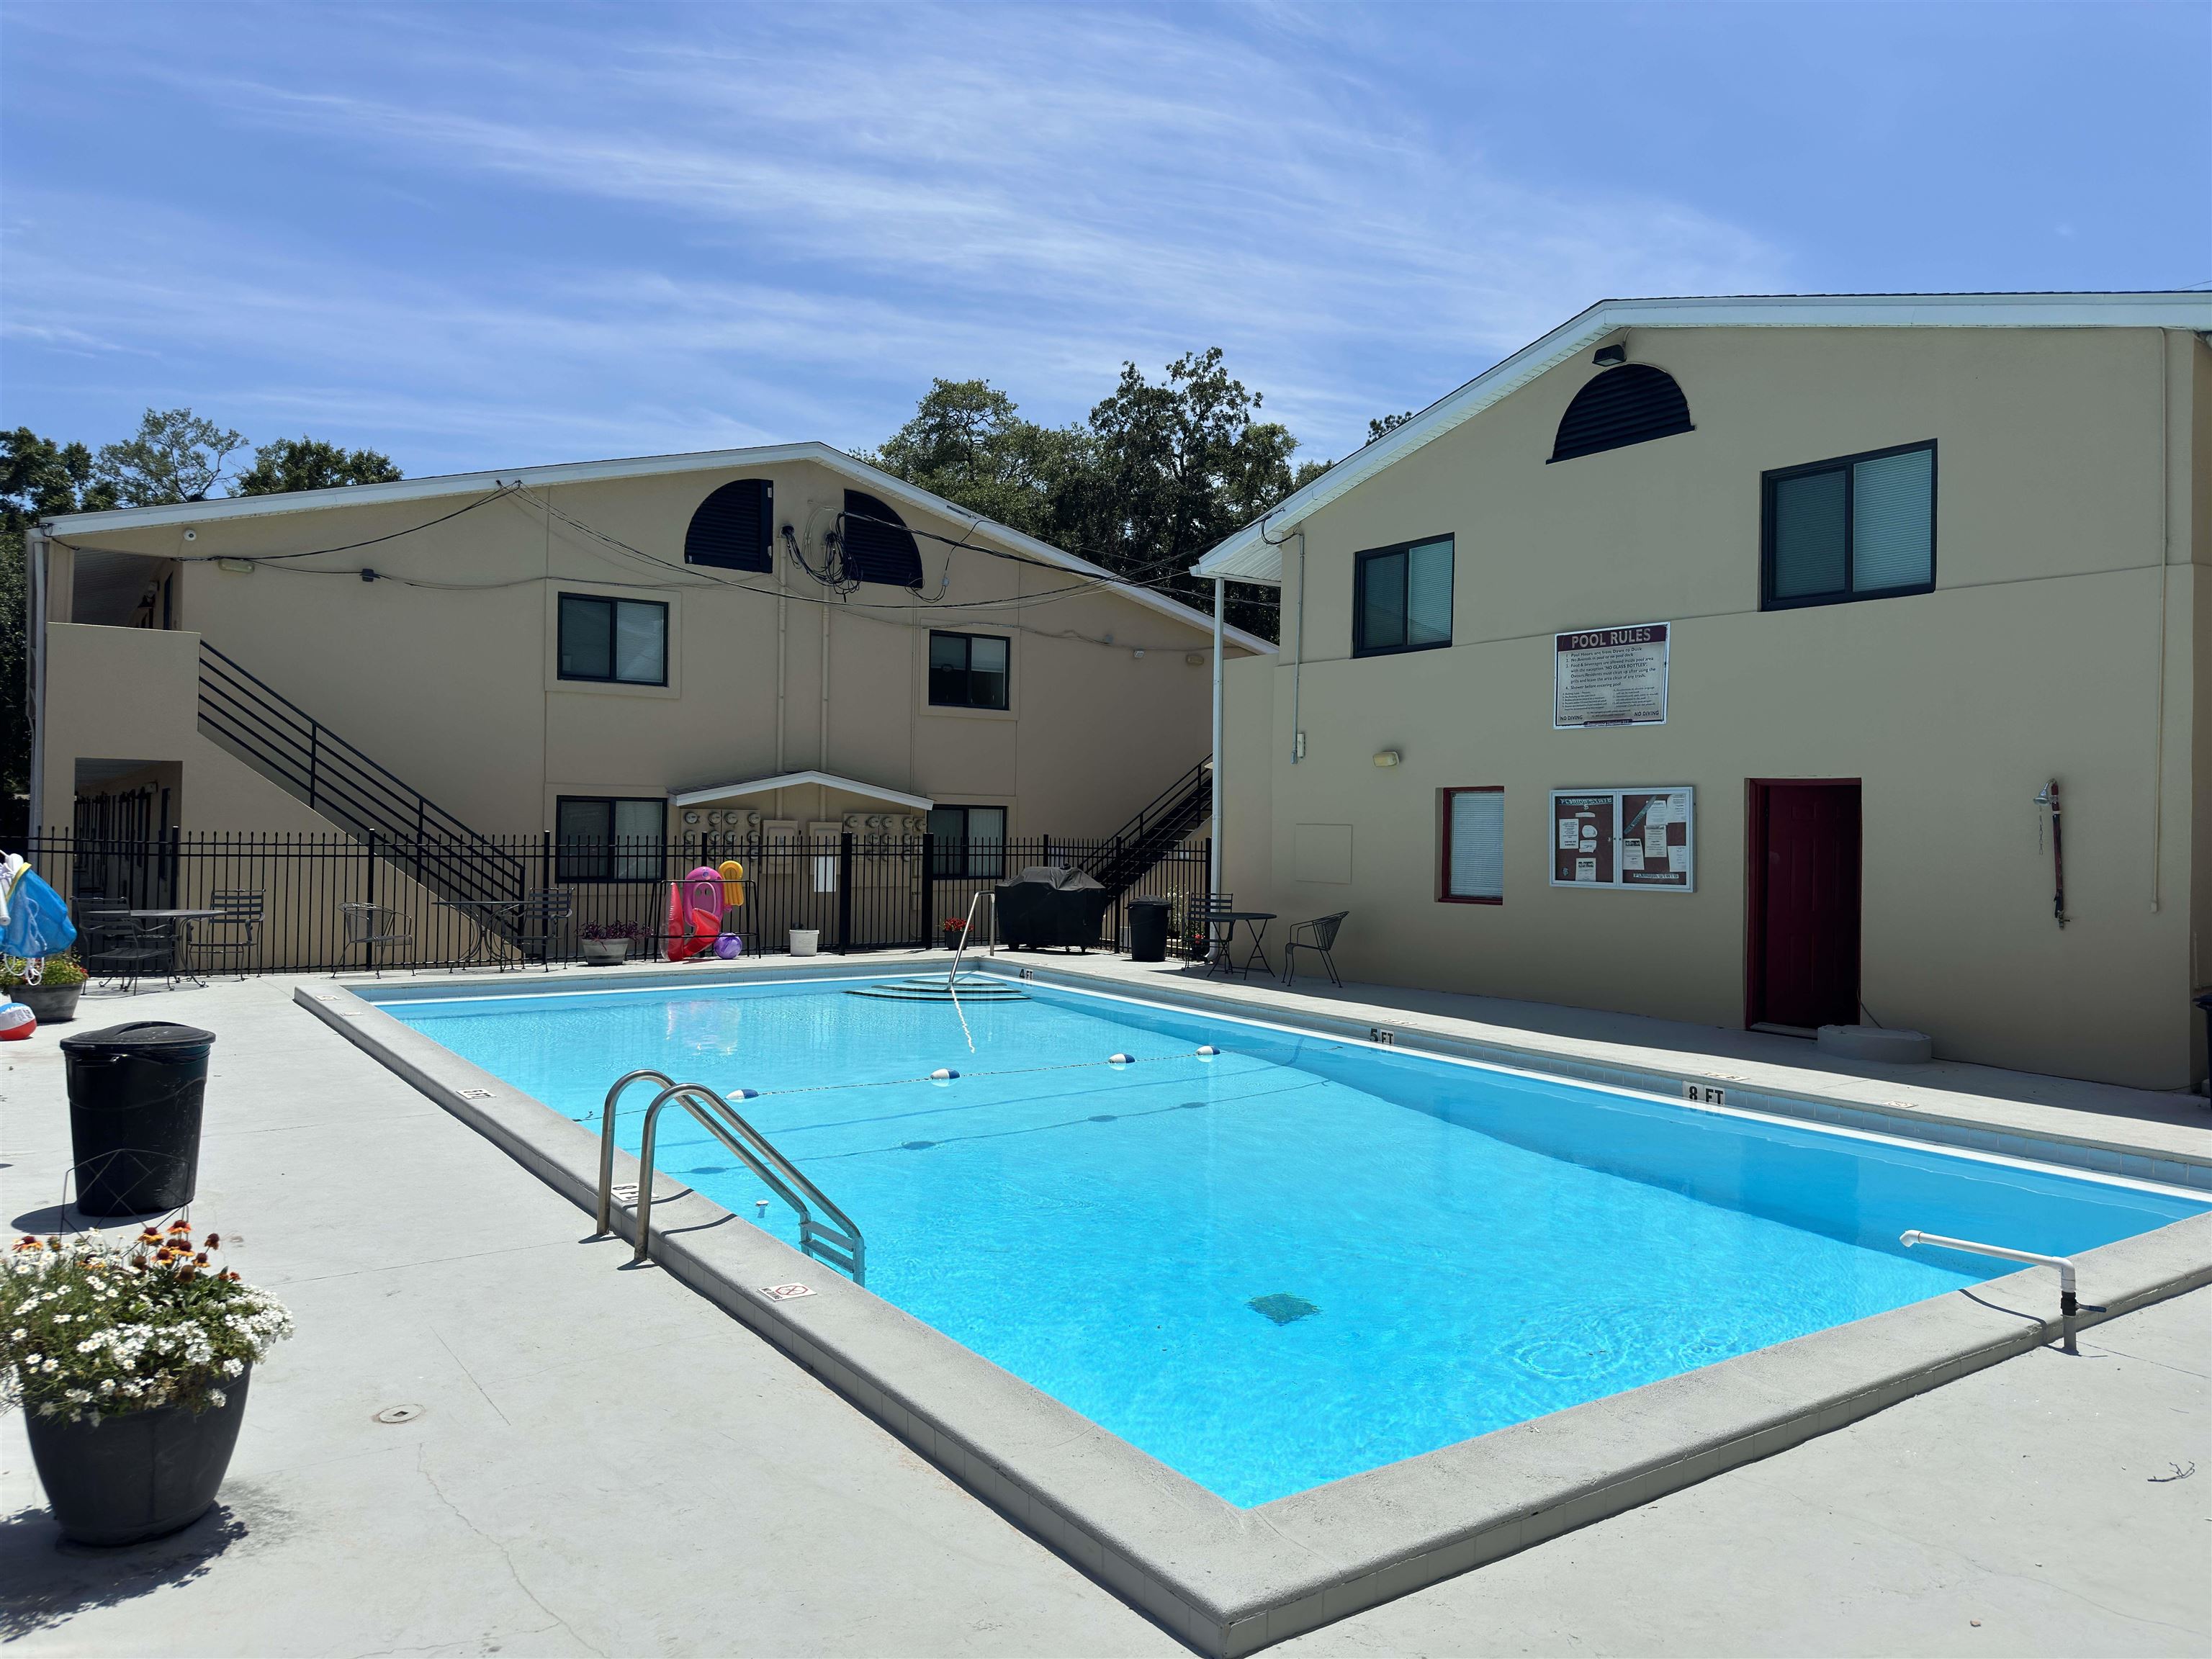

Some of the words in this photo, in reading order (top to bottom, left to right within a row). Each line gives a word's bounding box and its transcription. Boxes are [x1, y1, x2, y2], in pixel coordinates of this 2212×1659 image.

[1571, 634, 1606, 649] POOL
[1610, 628, 1651, 644] RULES
[1020, 968, 1025, 979] 4
[1026, 971, 1033, 979] FT
[1370, 1028, 1378, 1042] 5
[1381, 1031, 1393, 1044] FT
[1689, 1086, 1698, 1100] 8
[1705, 1088, 1724, 1105] FT
[766, 1291, 783, 1300] DIVING
